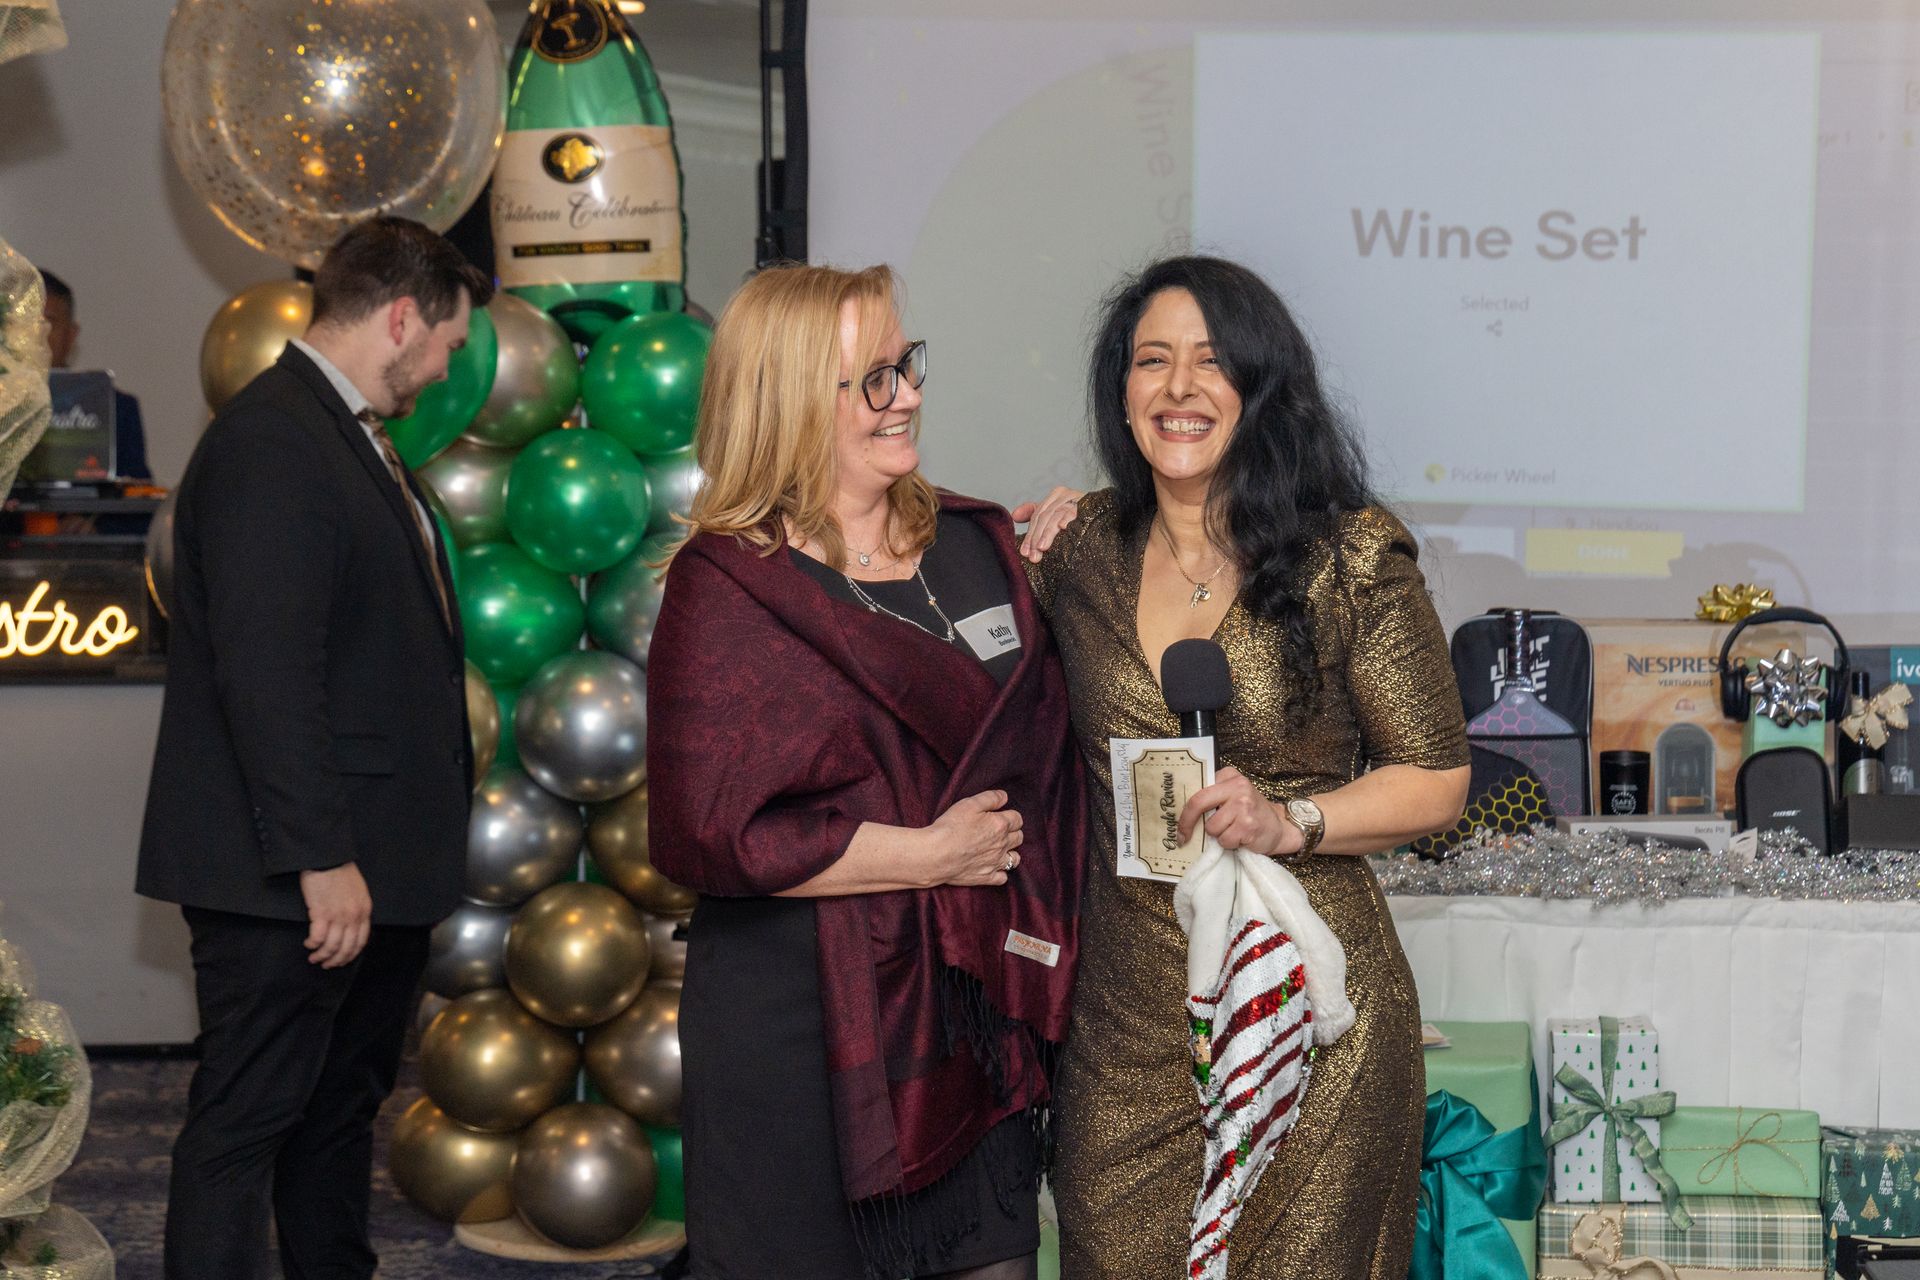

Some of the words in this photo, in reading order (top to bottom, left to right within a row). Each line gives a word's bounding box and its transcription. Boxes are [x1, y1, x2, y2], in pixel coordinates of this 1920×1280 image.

[1350, 207, 1513, 260] Wine
[1535, 208, 1648, 262] Set
[1460, 295, 1530, 312] Selected
[1450, 468, 1499, 483] Picker
[1504, 469, 1556, 485] Wheel
[987, 624, 1012, 640] Kathy
[1624, 652, 1746, 676] NESPRESO
[1160, 772, 1176, 811] Review
[1160, 812, 1178, 852] Google
